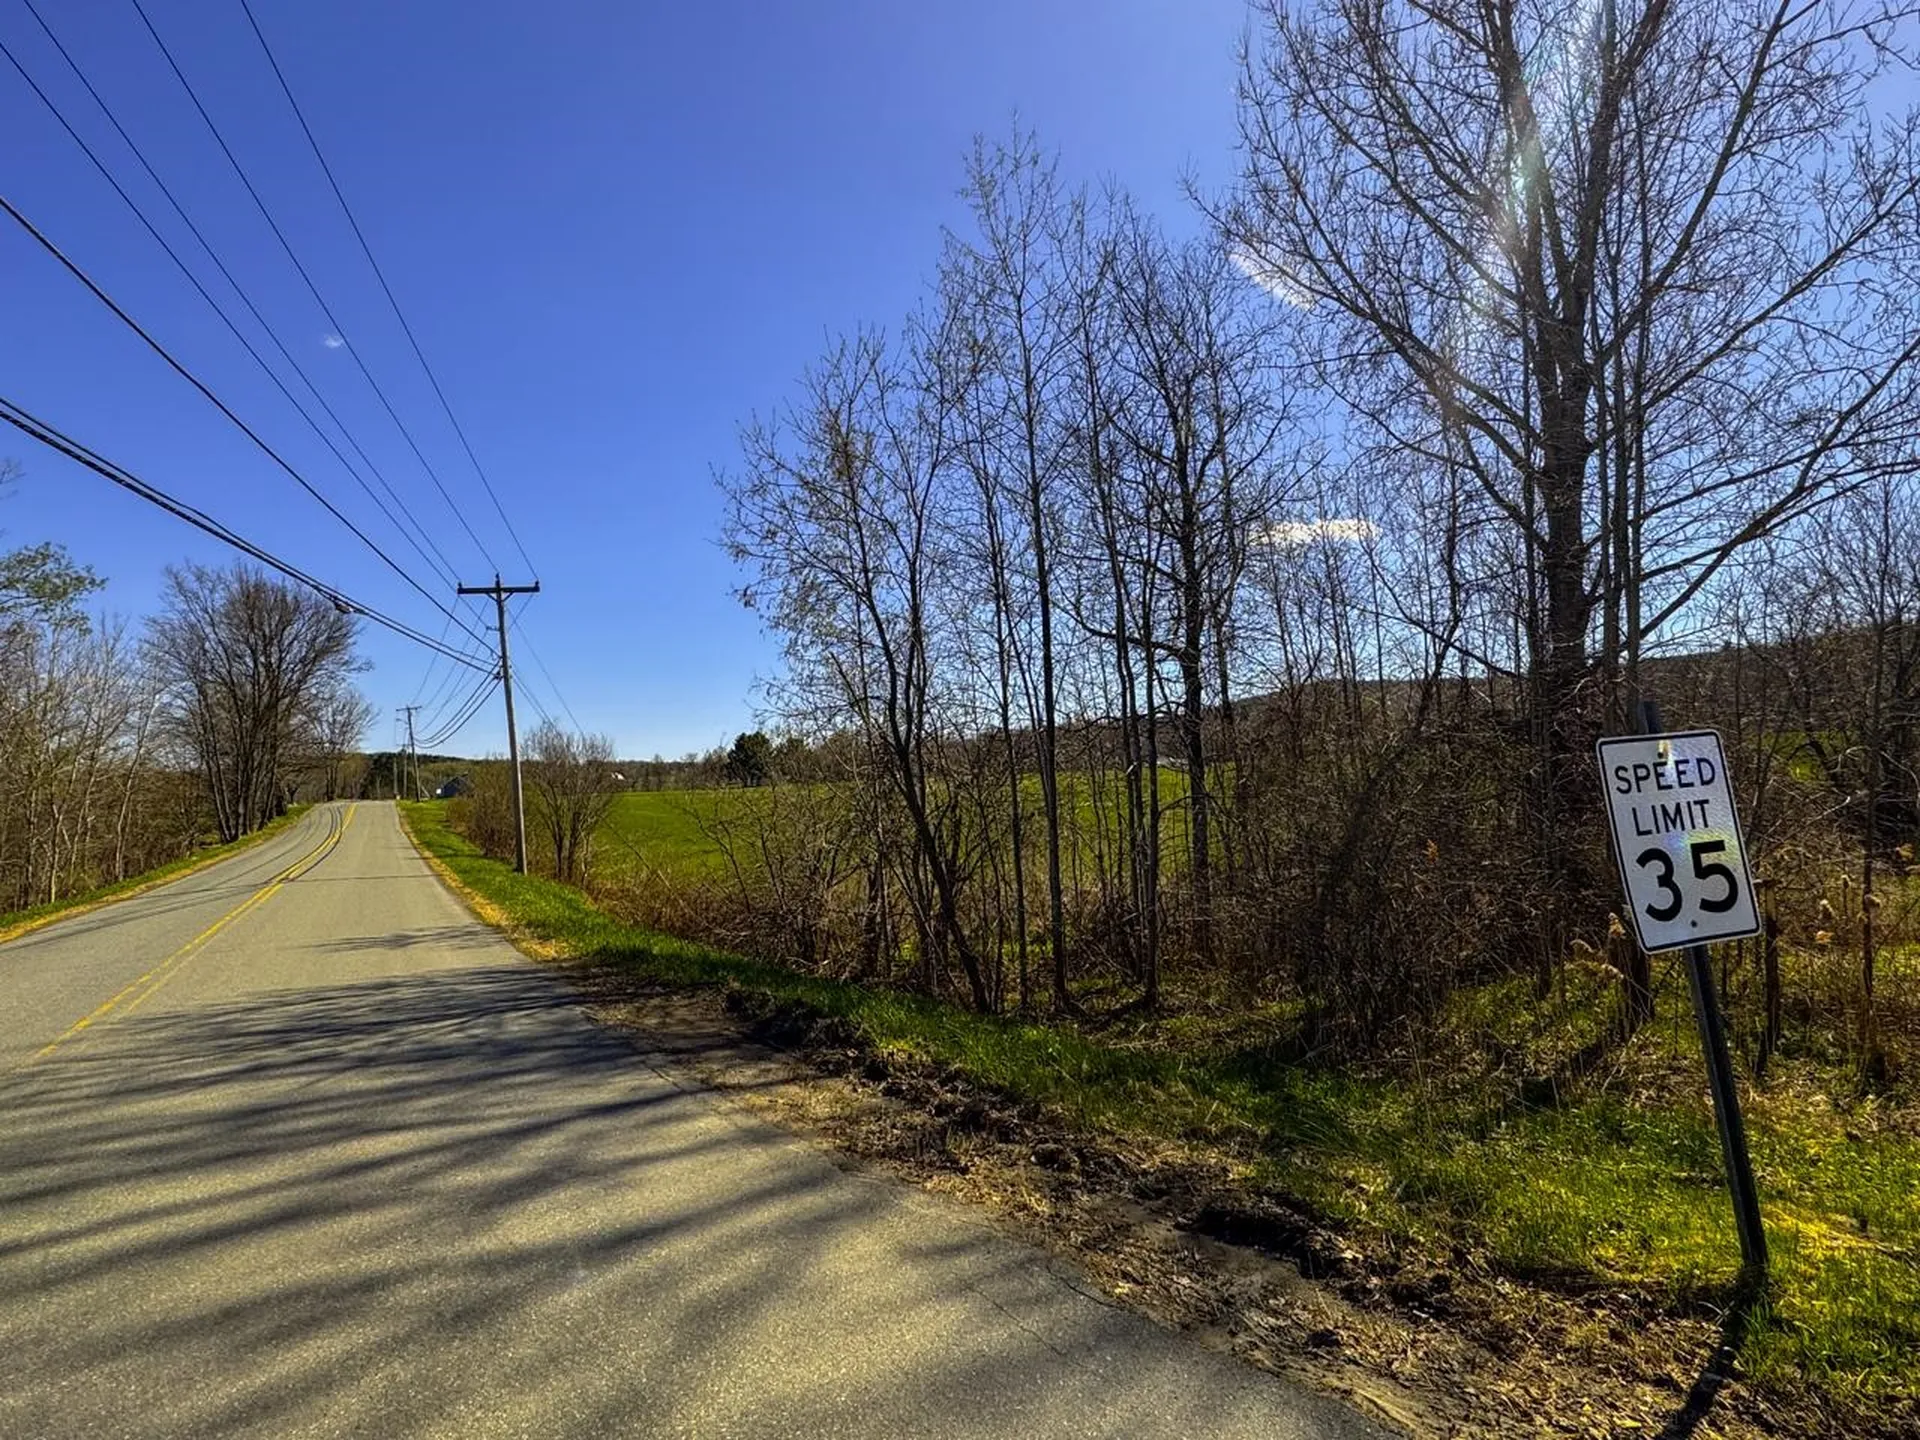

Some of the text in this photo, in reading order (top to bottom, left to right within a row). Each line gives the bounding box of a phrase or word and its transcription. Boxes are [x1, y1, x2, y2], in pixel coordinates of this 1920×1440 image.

[1614, 757, 1716, 795] SPEED
[1632, 799, 1710, 837] LIMIT
[1636, 840, 1739, 922] 35
